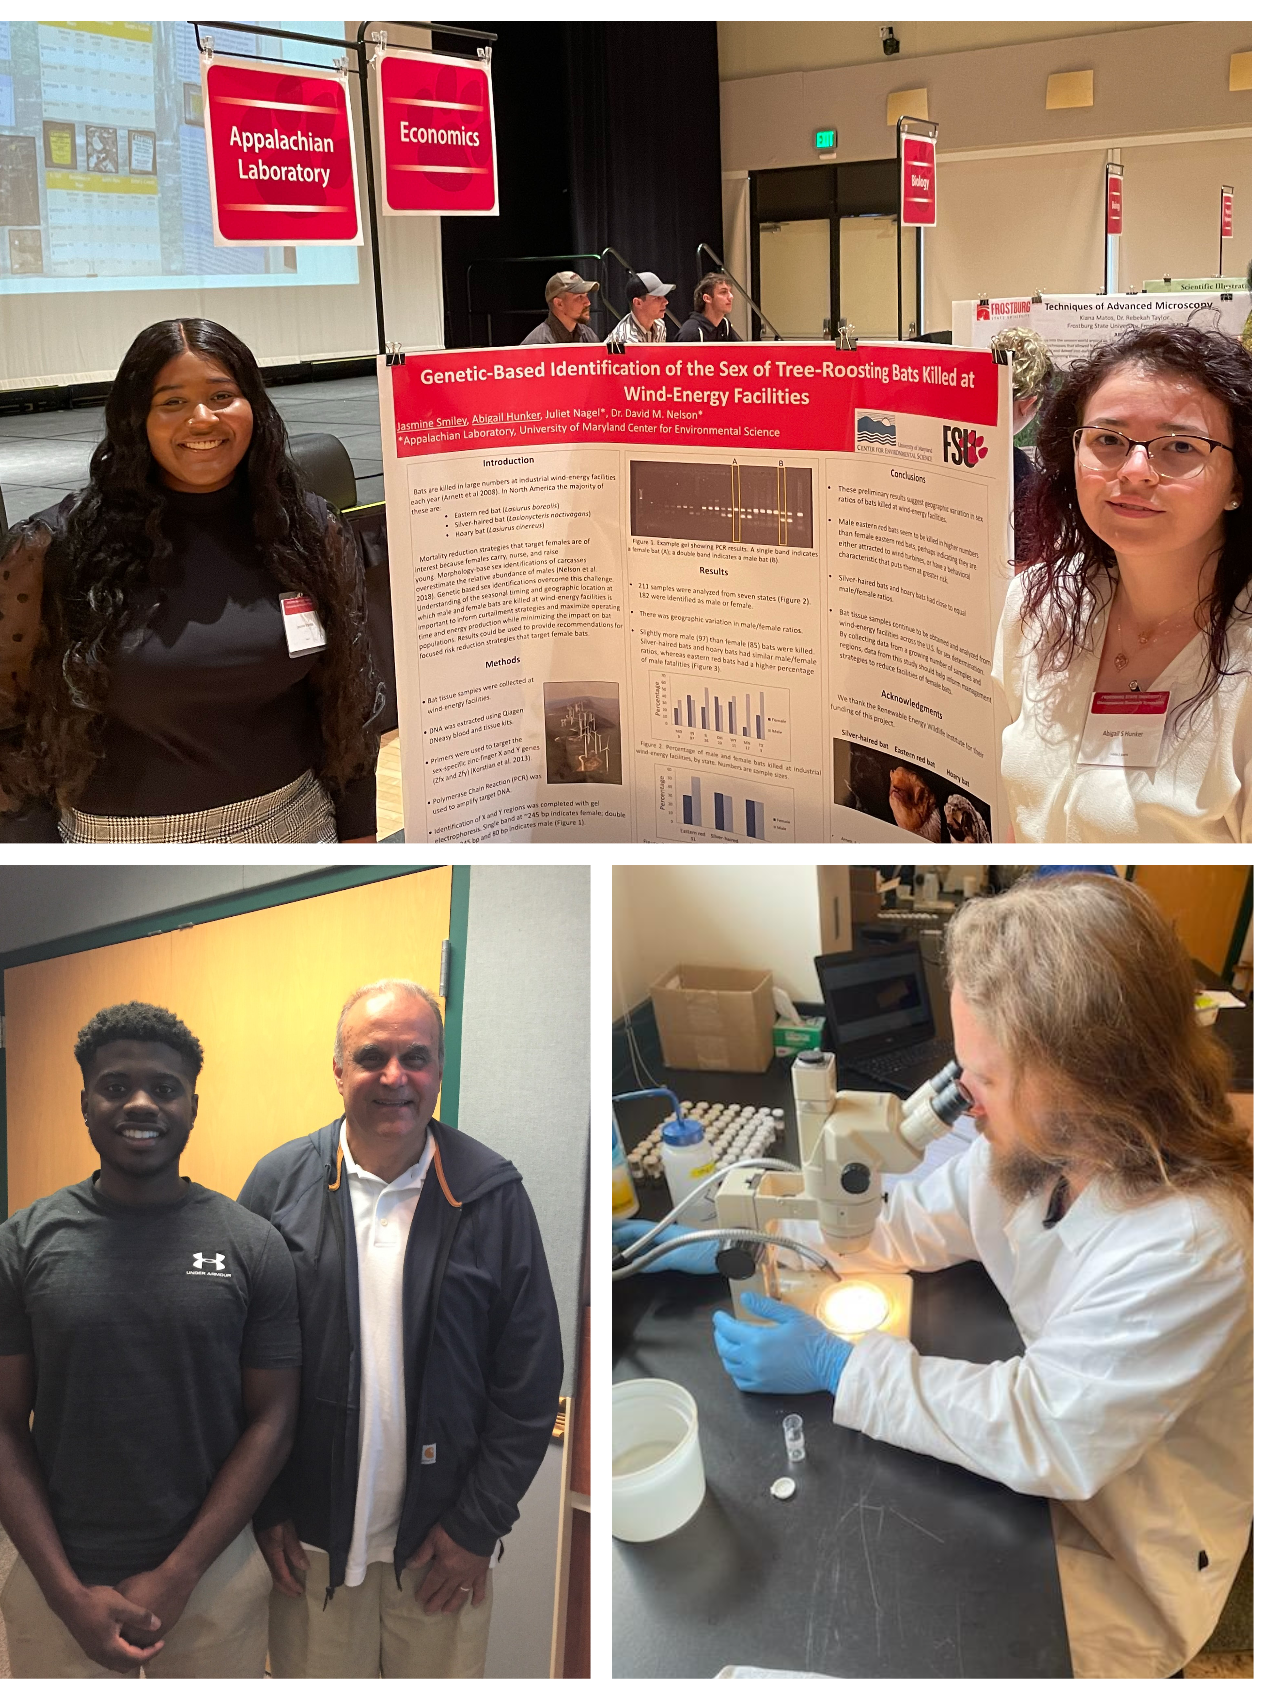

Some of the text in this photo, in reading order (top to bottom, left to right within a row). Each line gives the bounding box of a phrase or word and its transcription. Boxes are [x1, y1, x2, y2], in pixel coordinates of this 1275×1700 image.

[229, 125, 334, 154] Appalachian
[399, 121, 480, 148] Economics
[237, 159, 331, 188] Laboratory
[911, 175, 929, 190] Biology
[991, 301, 1030, 315] FROSTBURG
[1045, 302, 1092, 312] Techniques
[1156, 302, 1213, 310] Microscopy
[420, 360, 975, 388] Genetic-Based Identification of the Sex of Tree-Roosting Bats Killed at
[624, 385, 809, 406] Wind-Energy Facilities
[397, 418, 434, 432] Jasmine
[436, 416, 468, 428] Smiley,
[472, 412, 504, 424] Abigail
[507, 410, 542, 421] Hunker,
[545, 409, 570, 419] Juliet
[612, 409, 623, 418] Dr.
[625, 409, 649, 418] David
[652, 410, 664, 418] M.
[464, 427, 517, 440] Laboratory,
[520, 423, 566, 435] University
[570, 423, 579, 432] of
[582, 422, 625, 433] Maryland
[628, 423, 656, 433] Center
[659, 423, 672, 433] for
[675, 424, 741, 436] Environmental
[744, 427, 780, 437] Science
[885, 448, 917, 459] ENVIRONMENTAL
[943, 425, 978, 468] FSU
[483, 457, 534, 467] Introduction
[465, 481, 480, 490] large
[482, 479, 509, 487] numbers
[891, 469, 926, 484] Conclusions
[426, 495, 440, 504] year
[529, 484, 555, 492] America
[858, 488, 889, 498] preliminary
[411, 507, 427, 515] these
[454, 510, 477, 518] Eastern
[454, 518, 492, 528] Silver-haired
[455, 529, 473, 538] Hoary
[700, 567, 729, 576] Results
[651, 584, 674, 593] samples
[693, 587, 719, 597] analyzed
[757, 593, 776, 601] states
[778, 595, 800, 604] (Figure
[485, 656, 520, 668] Methods
[439, 693, 457, 701] tissue
[458, 687, 481, 697] samples
[483, 682, 498, 691] were
[499, 678, 526, 688] collected
[428, 700, 464, 714] wind-energy
[881, 689, 943, 720] Acknowledgments
[457, 716, 484, 727] extracted
[503, 708, 524, 717] Qiagen
[430, 735, 451, 745] DNeasy
[453, 729, 470, 739] blood
[484, 722, 500, 731] tissue
[842, 729, 888, 750] Silver-haired bat
[894, 746, 936, 768] Eastern red bat
[946, 769, 970, 787] Hoary bat
